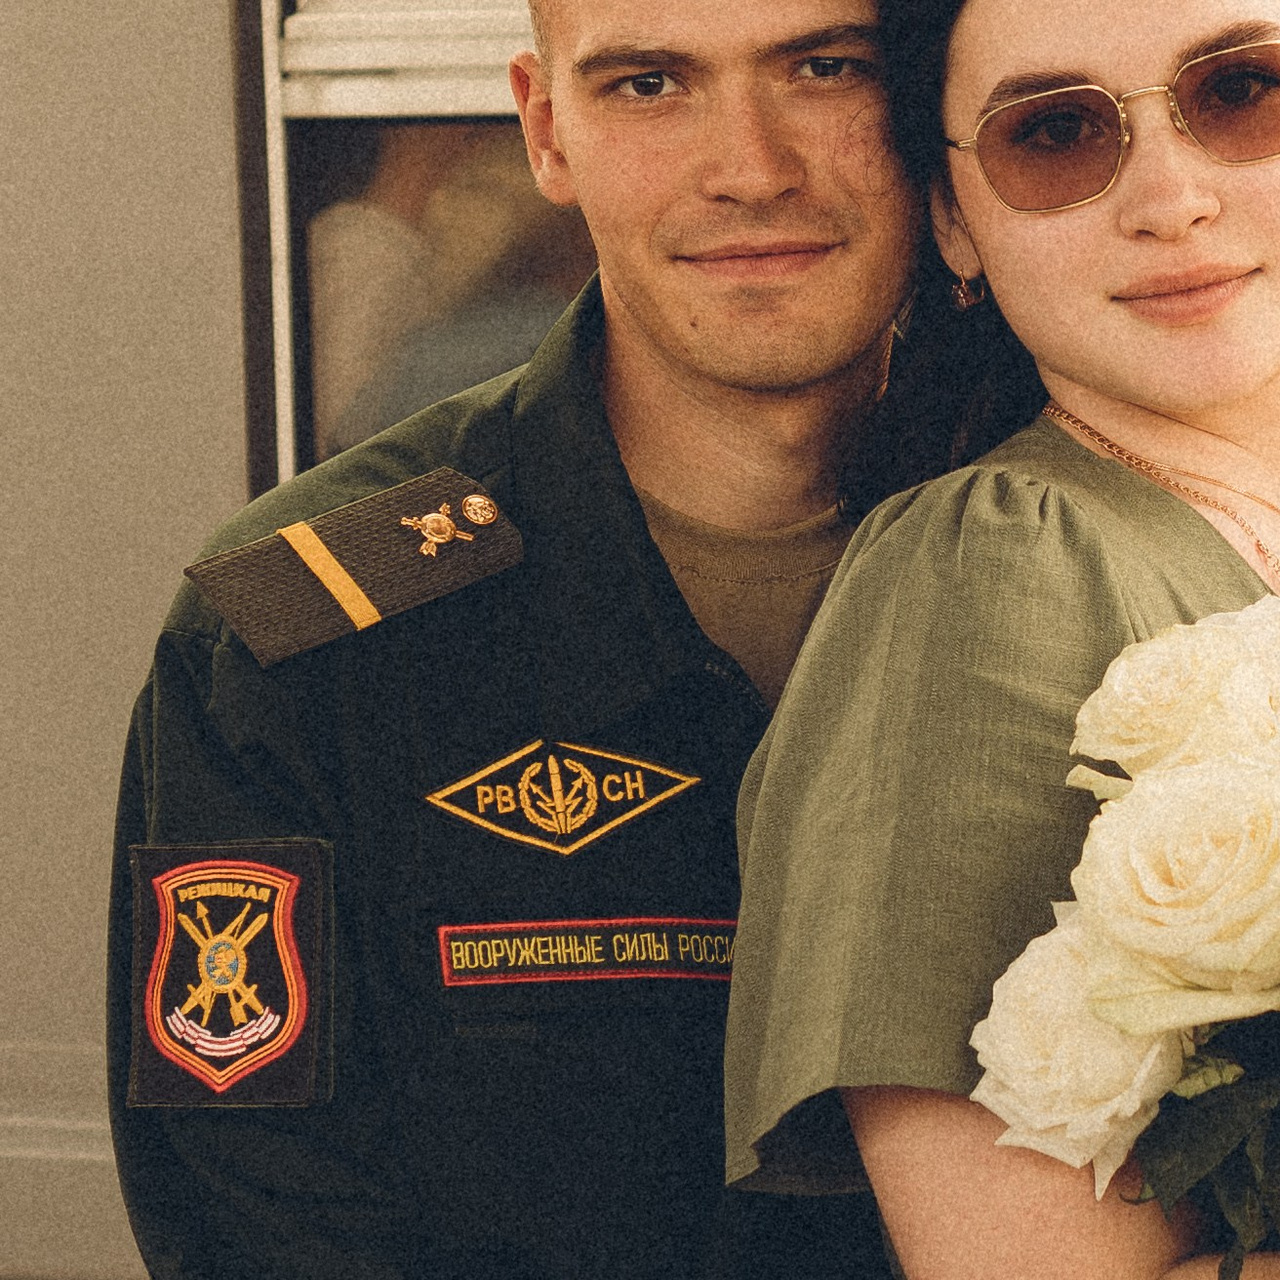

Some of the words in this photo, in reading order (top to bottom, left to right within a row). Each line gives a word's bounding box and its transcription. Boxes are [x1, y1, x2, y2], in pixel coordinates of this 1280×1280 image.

[475, 784, 517, 814] РВ
[602, 770, 646, 802] СН
[450, 934, 606, 970] ВООРУЖЕННЫЕ
[612, 932, 669, 962] СИЛЫ
